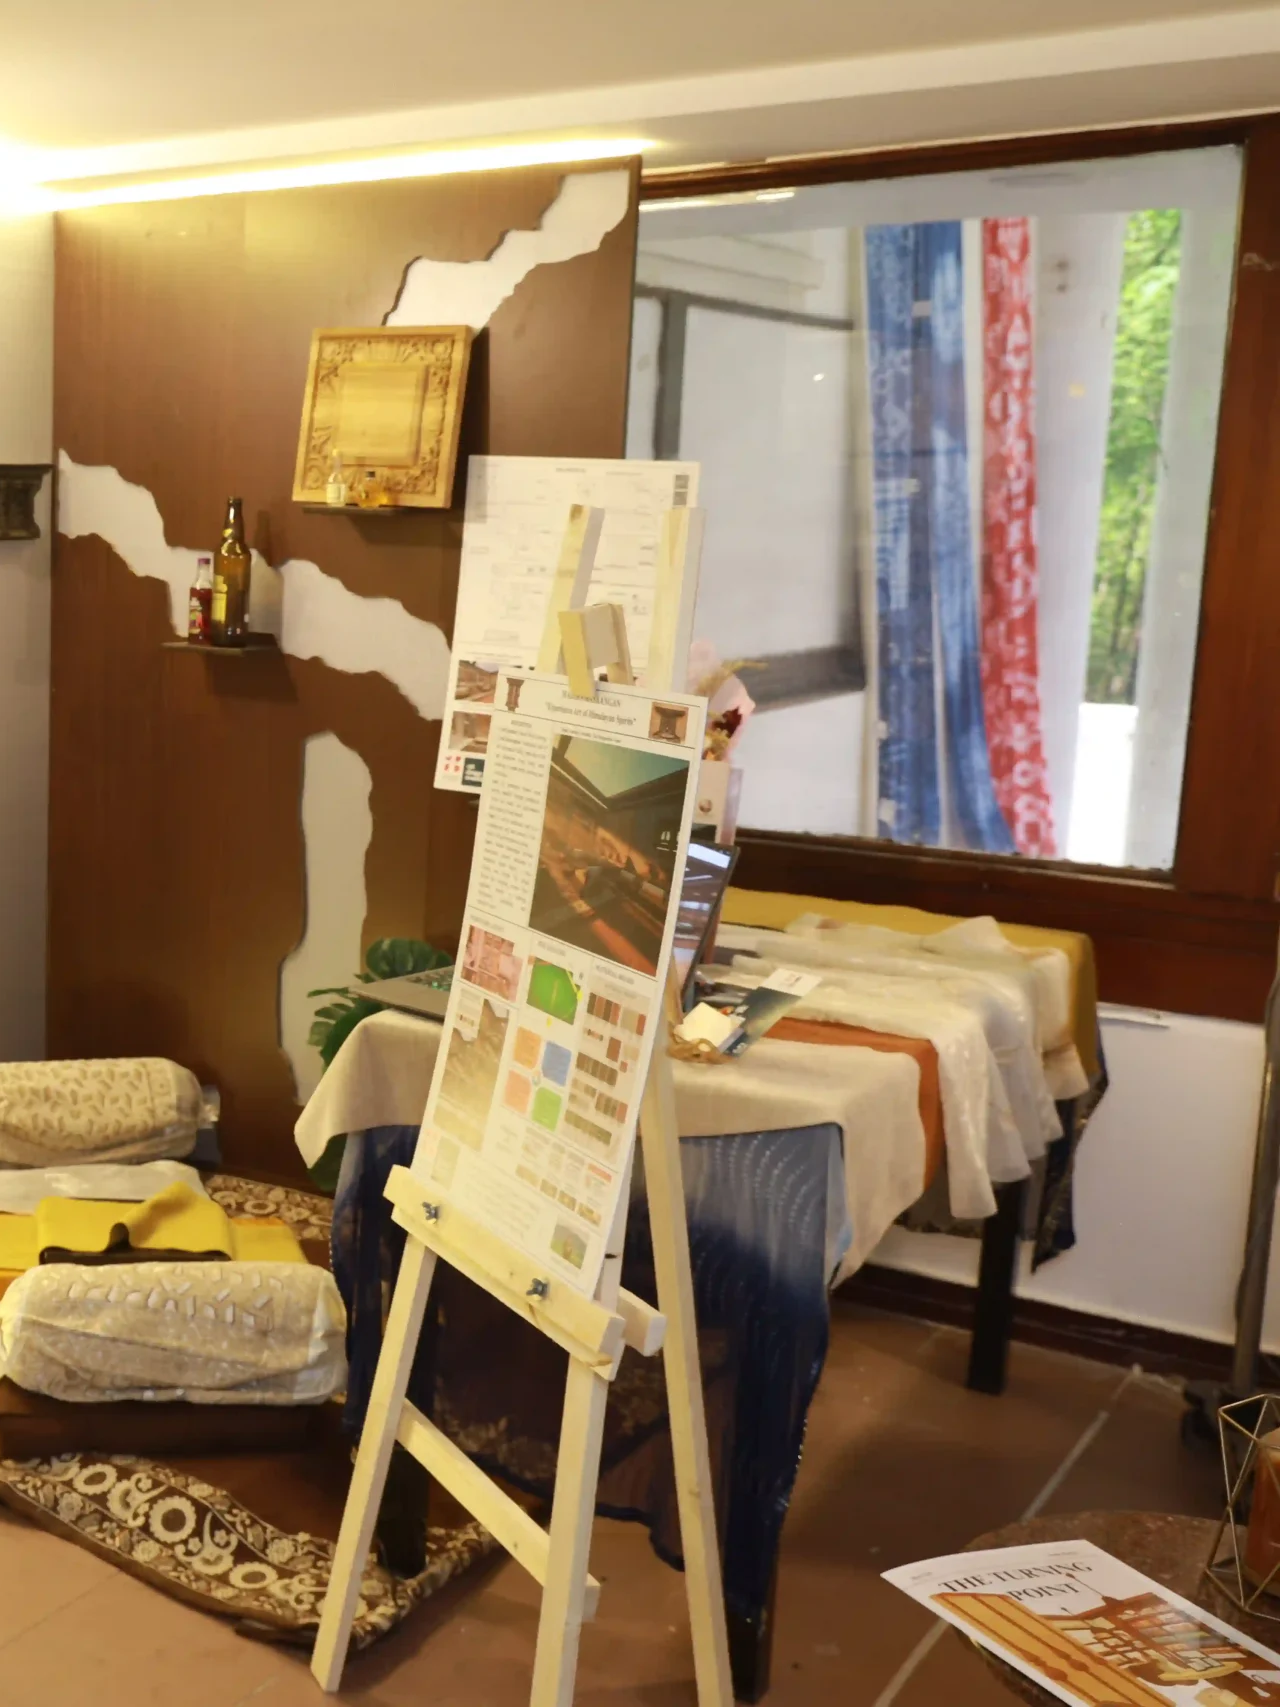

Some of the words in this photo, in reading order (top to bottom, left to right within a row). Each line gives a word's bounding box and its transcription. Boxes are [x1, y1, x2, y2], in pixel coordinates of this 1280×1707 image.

[937, 1573, 992, 1592] THE
[987, 1561, 1093, 1583] TURNING
[1006, 1582, 1081, 1602] POINT
